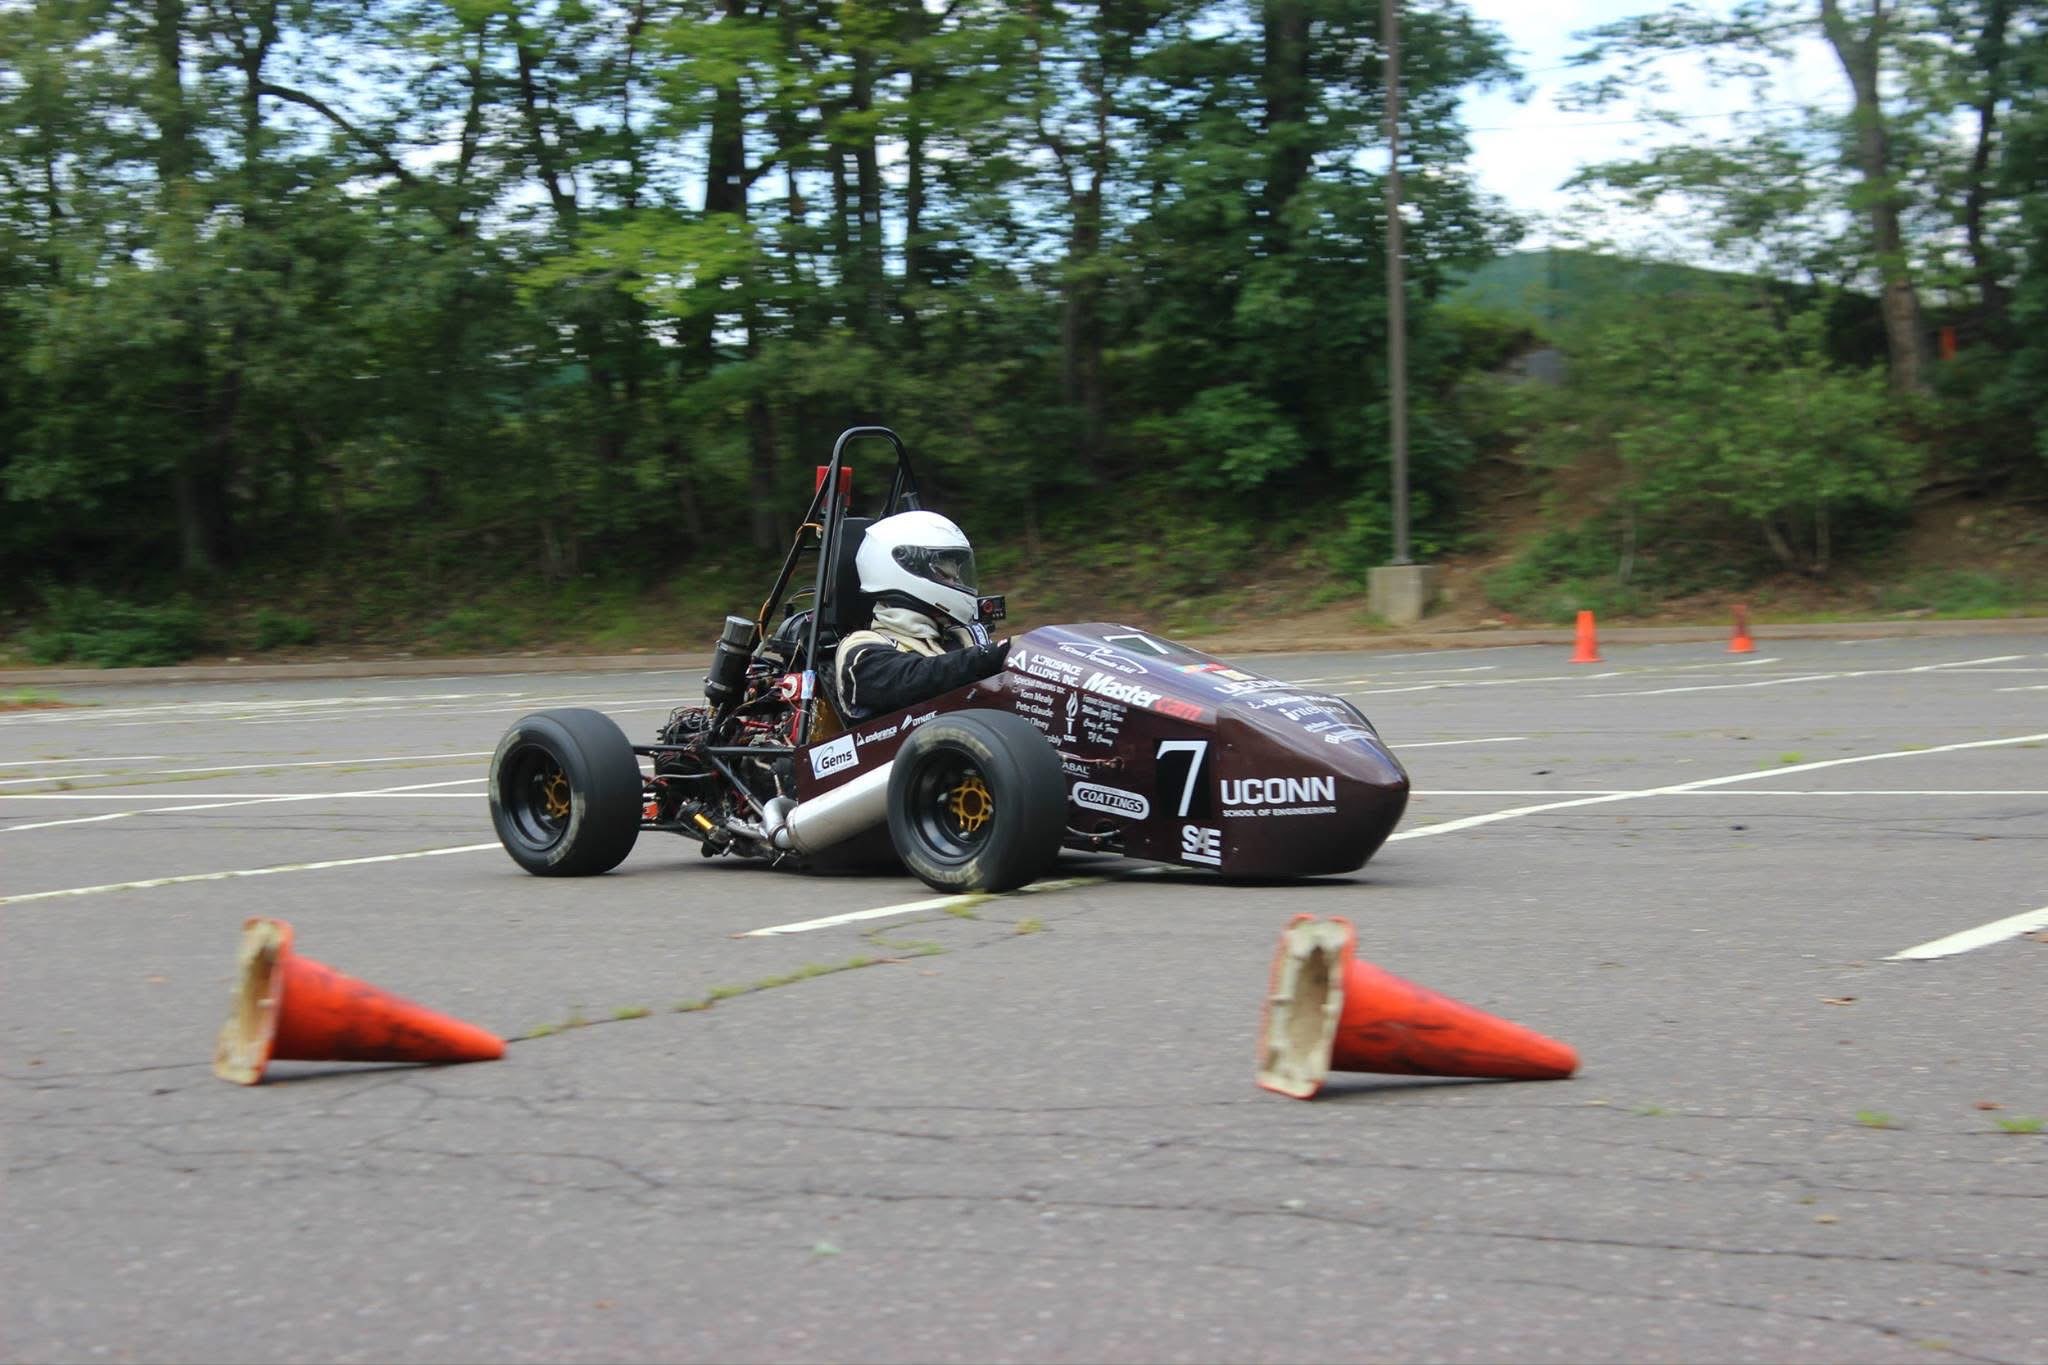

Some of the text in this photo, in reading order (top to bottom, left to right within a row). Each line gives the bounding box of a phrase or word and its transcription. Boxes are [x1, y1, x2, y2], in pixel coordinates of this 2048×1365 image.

[1031, 654, 1084, 676] AEROSPACE
[1015, 701, 1030, 712] Pete
[821, 751, 853, 769] Gems
[1156, 740, 1208, 817] 7
[1080, 790, 1142, 812] COATINGS
[1220, 776, 1336, 805] UCONN
[1222, 806, 1337, 817] SCHOOL OF ENGINEERING
[1182, 824, 1221, 857] SAE
